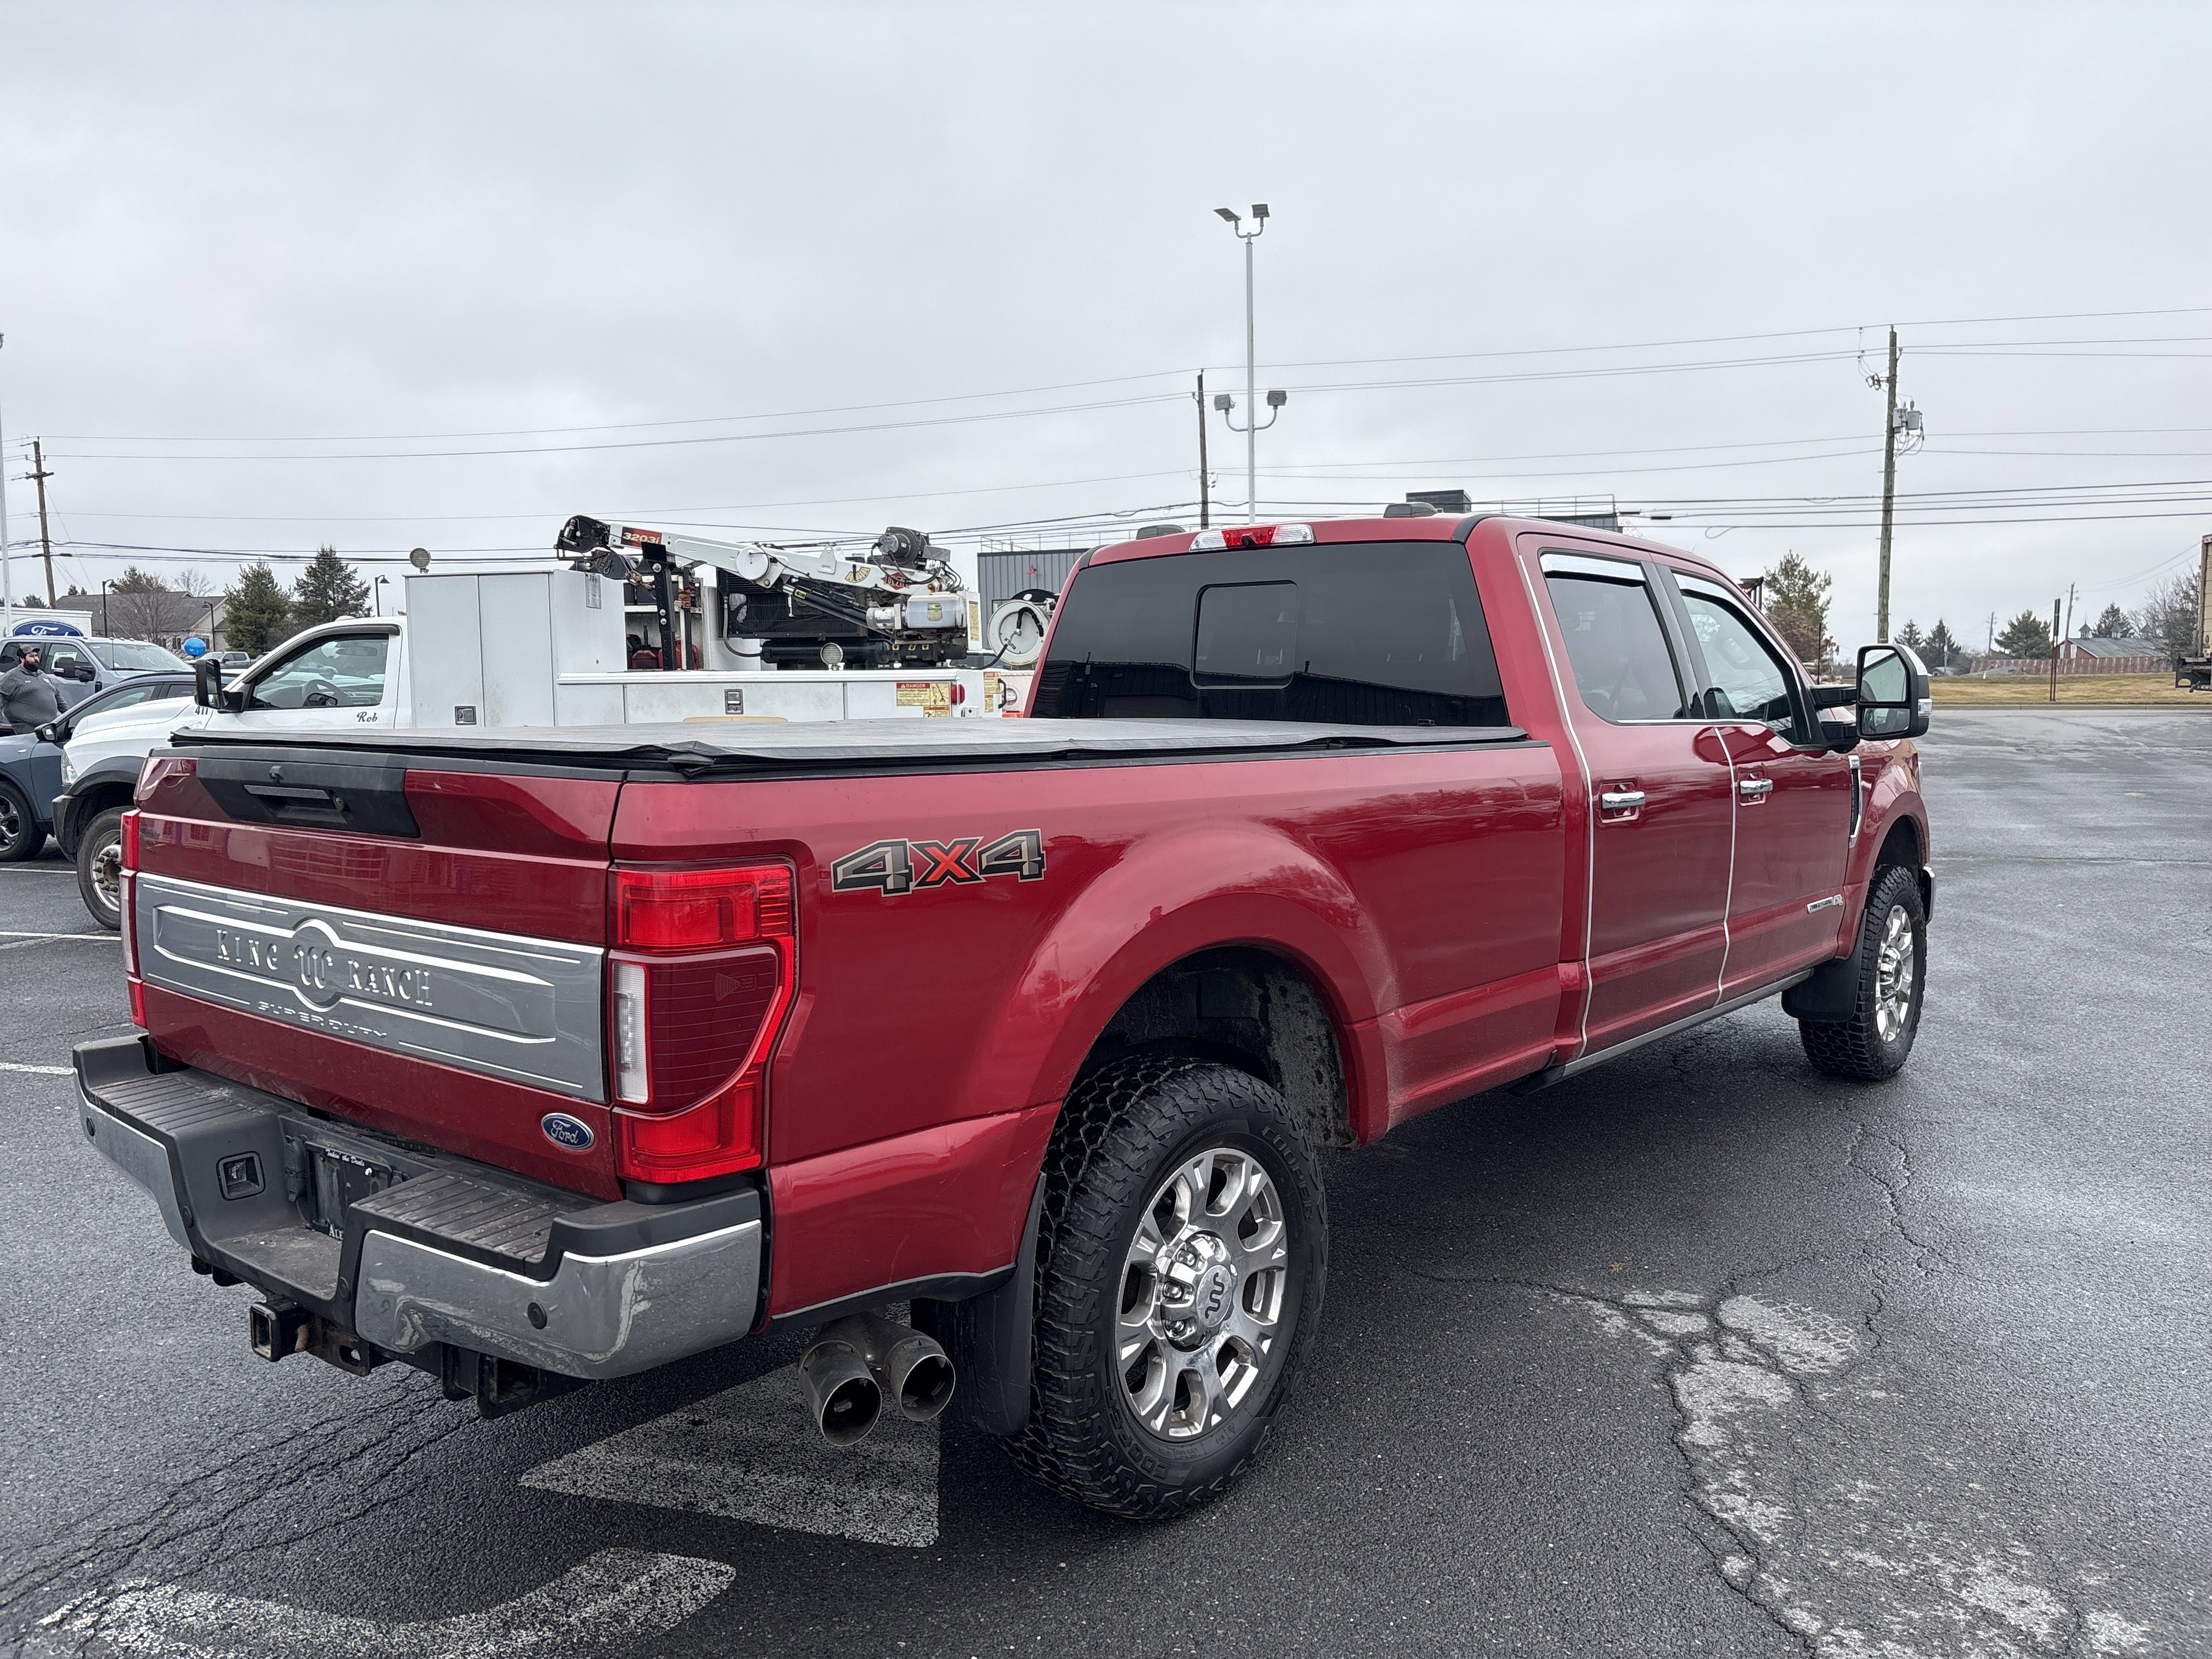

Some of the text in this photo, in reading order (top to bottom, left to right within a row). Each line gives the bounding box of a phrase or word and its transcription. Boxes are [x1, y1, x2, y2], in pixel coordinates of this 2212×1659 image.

[622, 532, 660, 544] 3203i
[357, 712, 377, 722] Rob
[831, 828, 1047, 898] 4X4
[216, 929, 433, 1006] KING RANCH
[257, 1001, 325, 1026] SUPER
[550, 1120, 579, 1144] Ford
[1261, 1125, 1315, 1221] COOPER
[1105, 1387, 1170, 1480] COOPER
